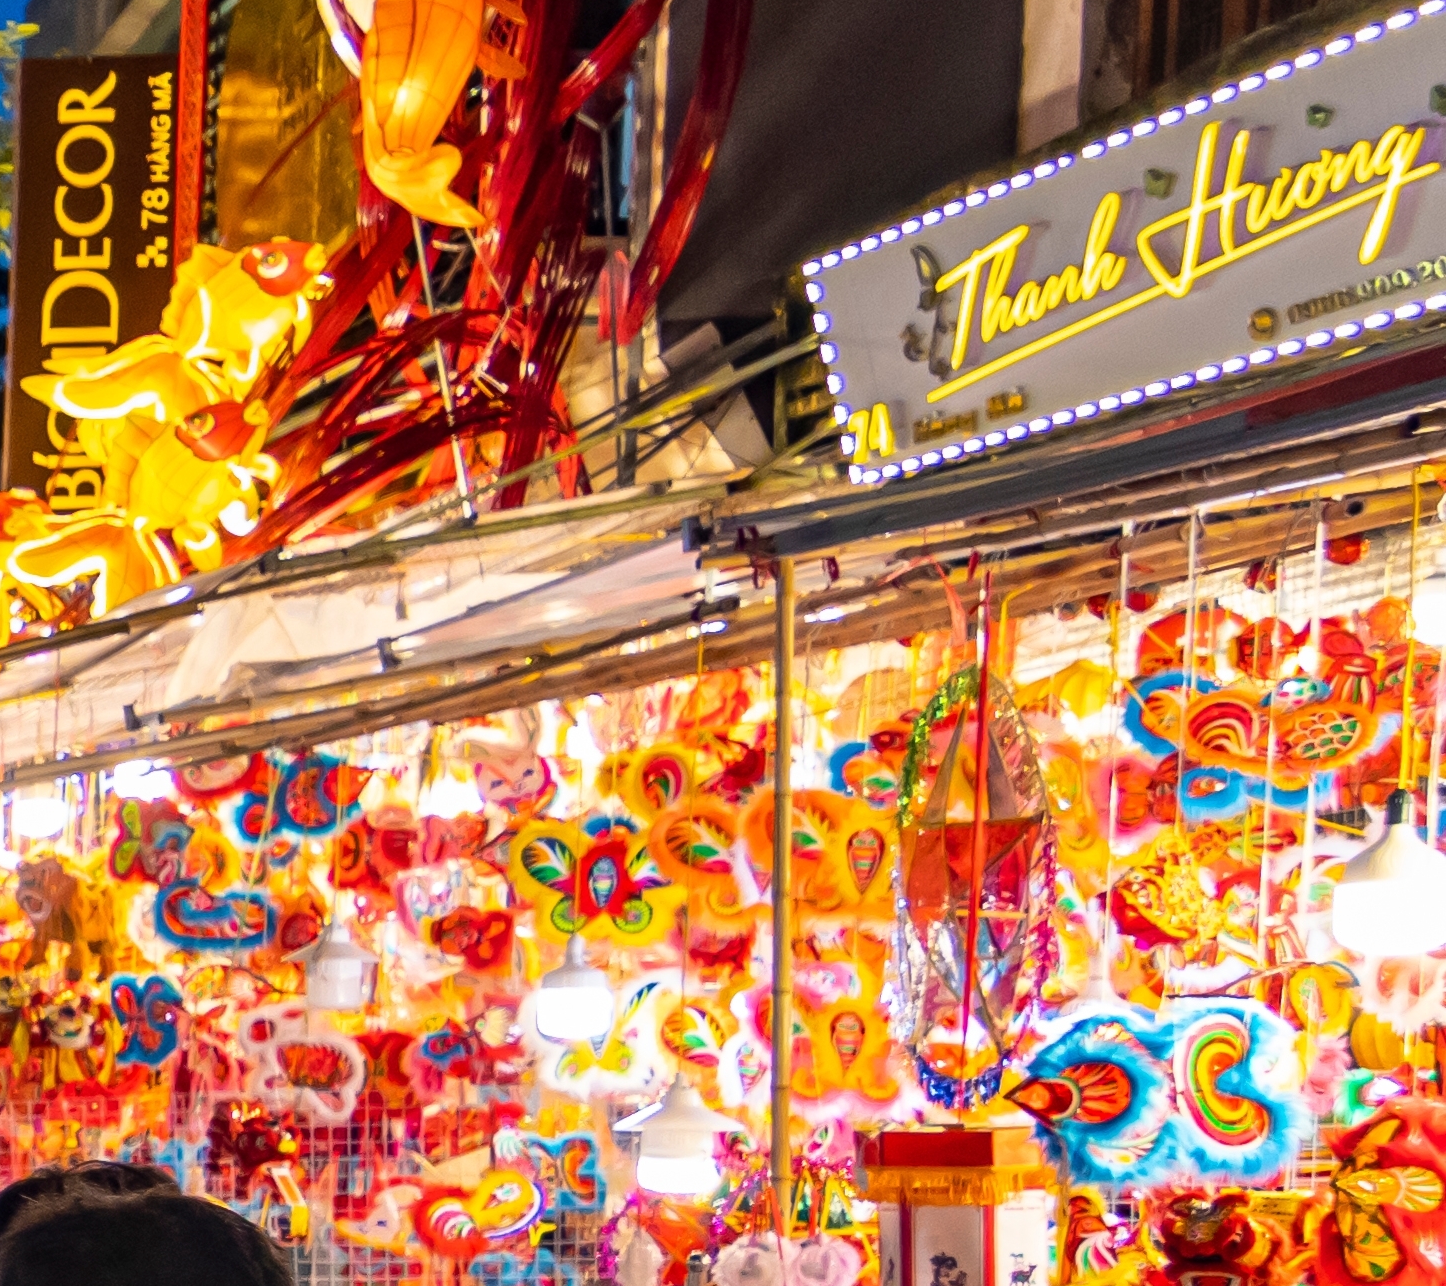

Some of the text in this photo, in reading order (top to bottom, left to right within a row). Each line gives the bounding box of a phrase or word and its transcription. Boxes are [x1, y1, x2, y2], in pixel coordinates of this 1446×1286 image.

[41, 70, 119, 347] DECOR
[141, 187, 170, 231] 78
[146, 115, 172, 183] HÀNG
[935, 193, 1128, 371] Thanh
